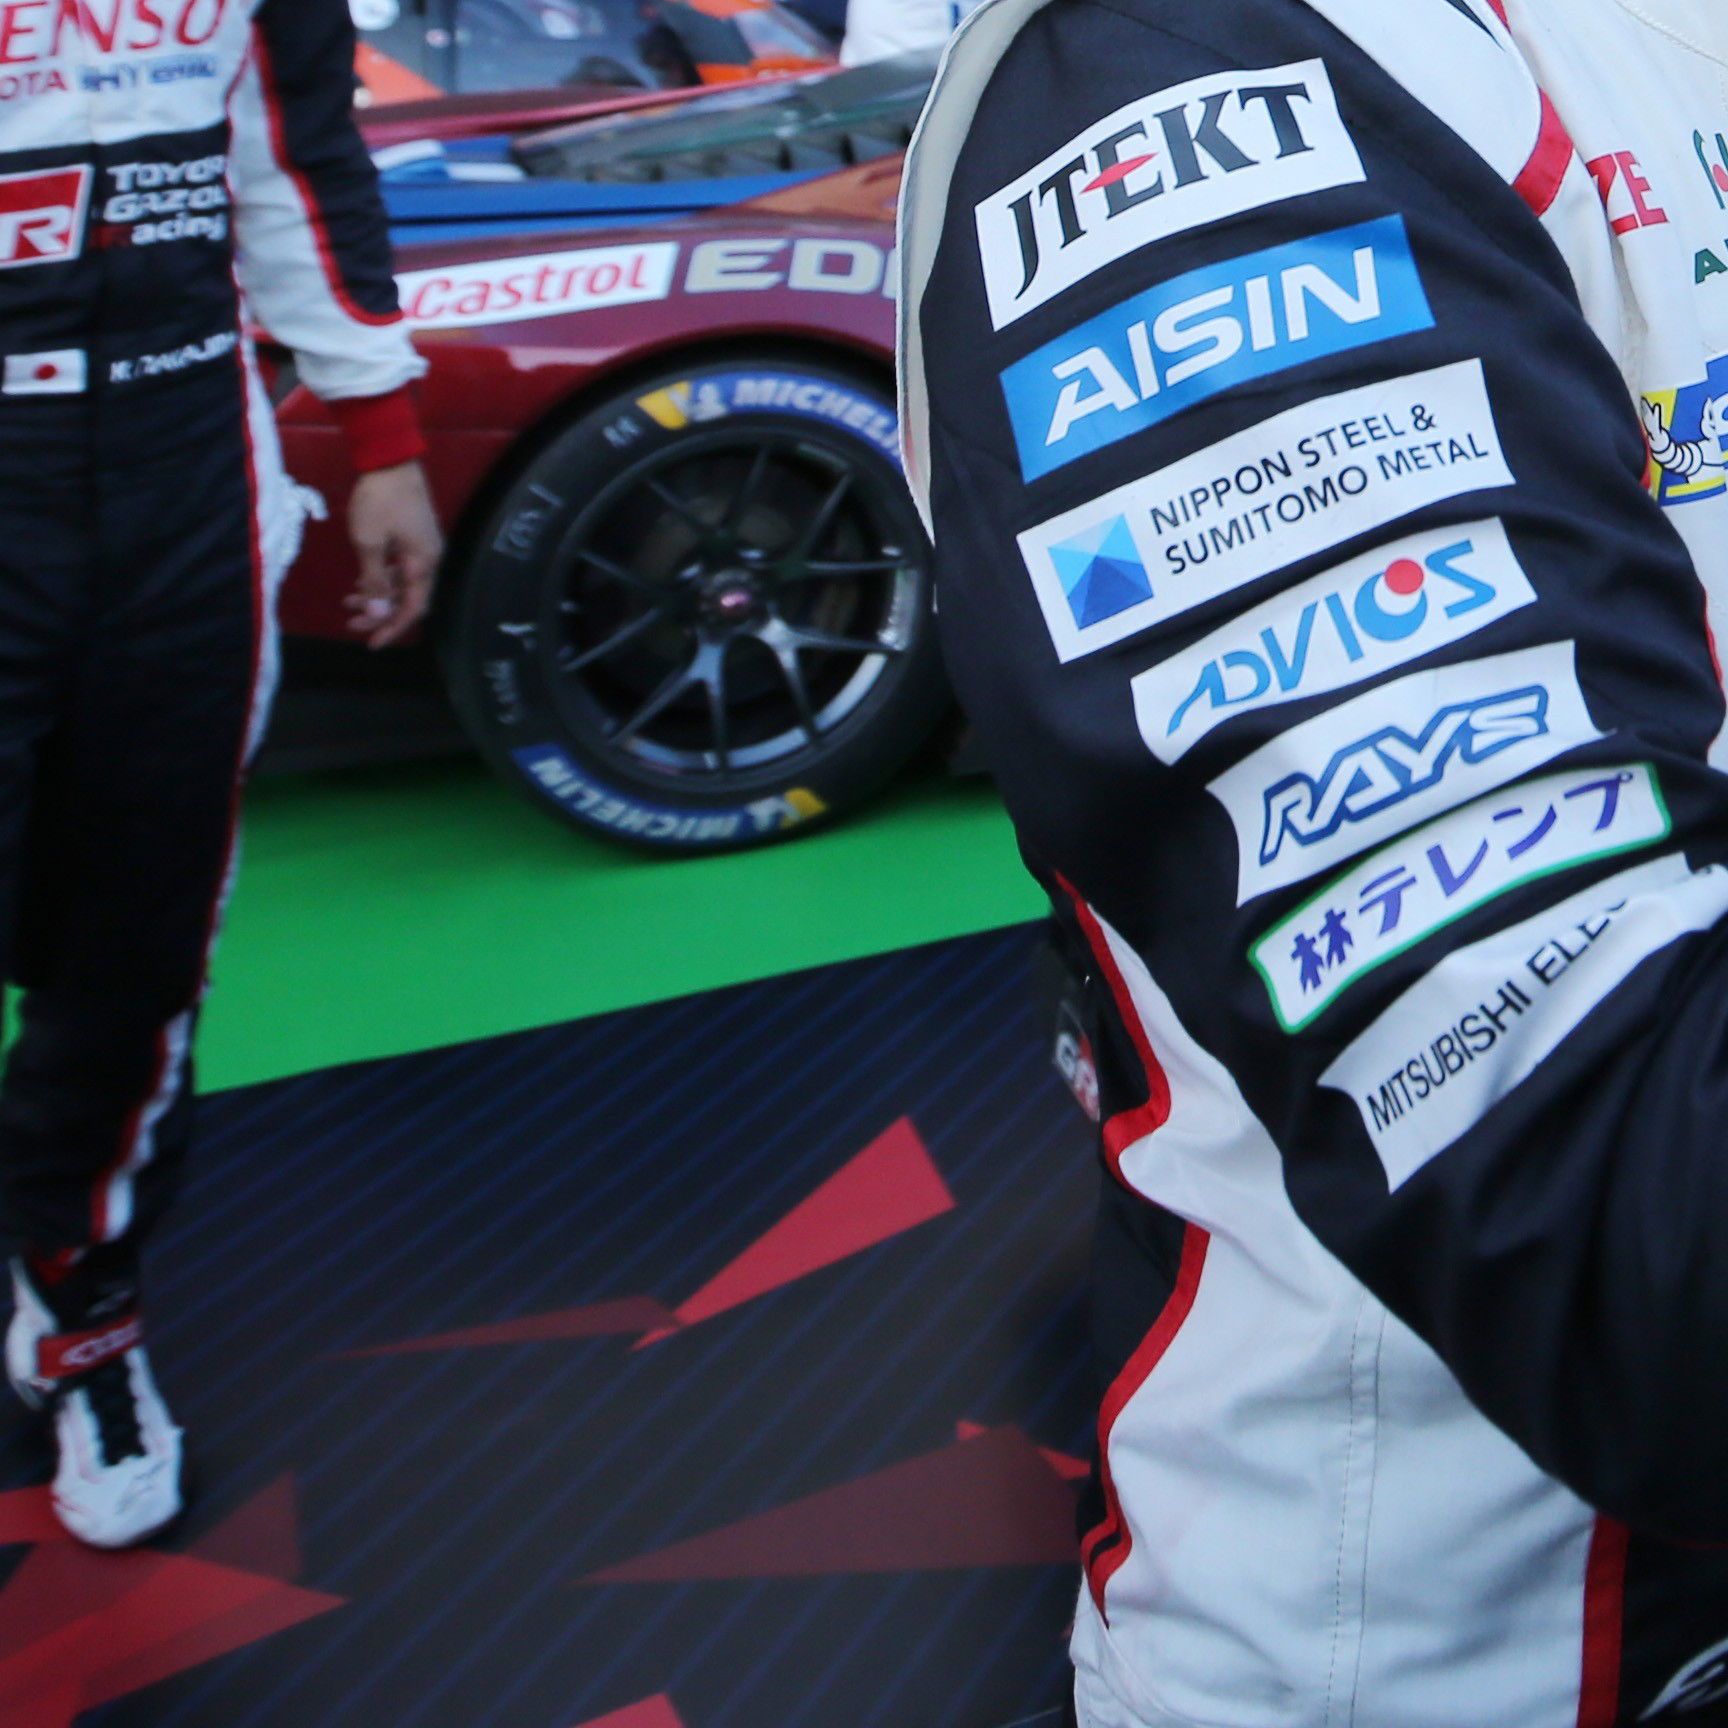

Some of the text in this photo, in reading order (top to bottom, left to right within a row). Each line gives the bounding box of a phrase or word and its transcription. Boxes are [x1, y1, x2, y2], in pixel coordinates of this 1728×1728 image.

[1007, 83, 1314, 300] JTEKT
[412, 238, 896, 322] Castrol ED
[1045, 246, 1382, 447] AISIN
[1150, 403, 1438, 536] NIPPON STEEL &
[1165, 432, 1490, 576] SUMITOMO METAL
[1167, 538, 1498, 736] ADVICS
[529, 757, 740, 842] MICHELIN
[1259, 684, 1550, 866] RAYS
[1290, 771, 1635, 991] 林テレンプ
[1365, 979, 1533, 1133] MITSUBISHI
